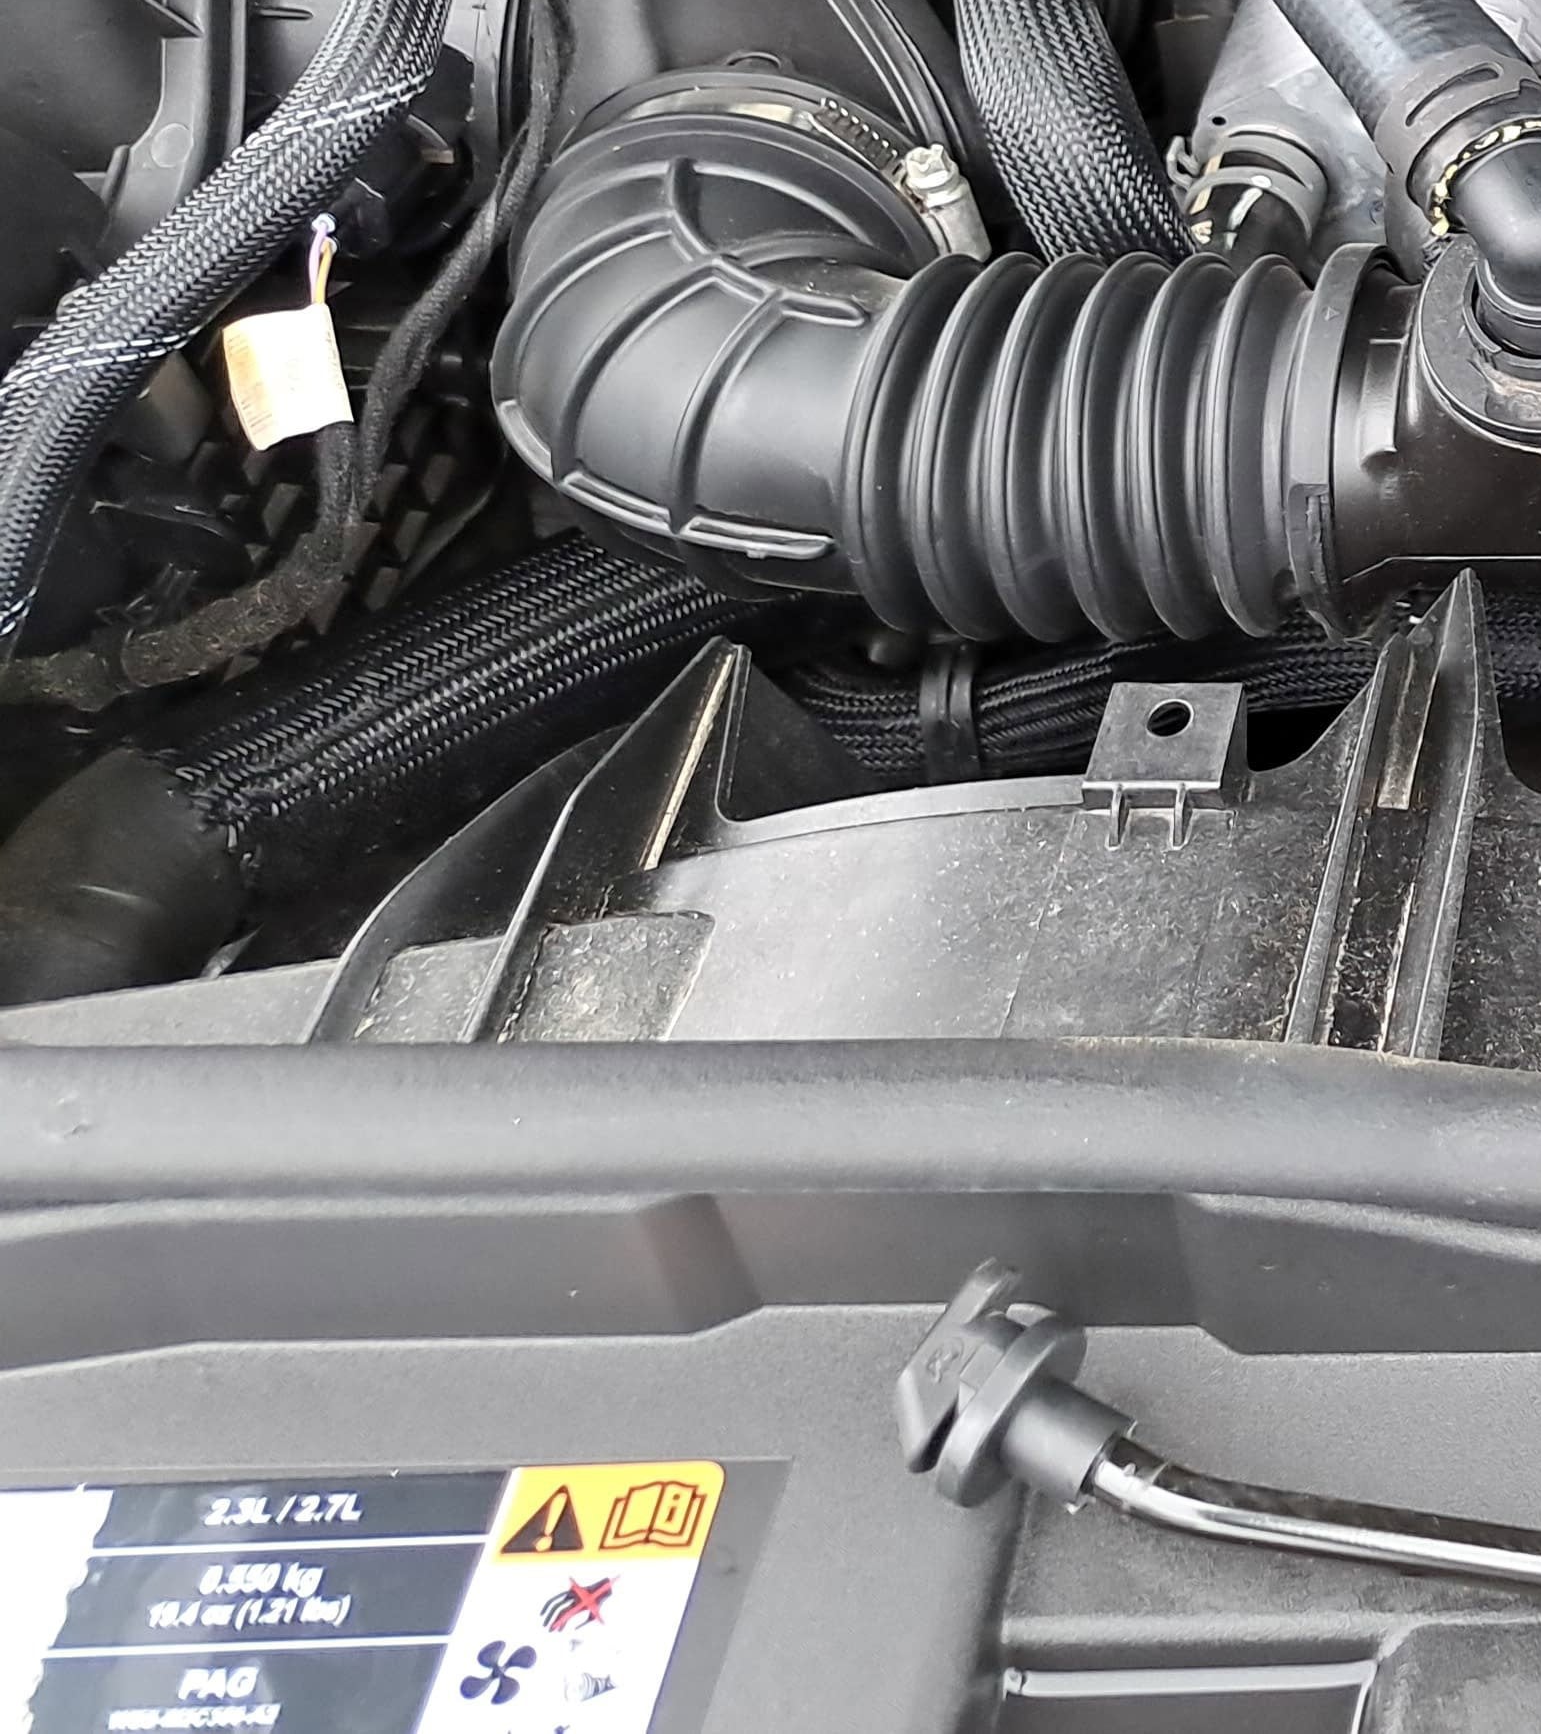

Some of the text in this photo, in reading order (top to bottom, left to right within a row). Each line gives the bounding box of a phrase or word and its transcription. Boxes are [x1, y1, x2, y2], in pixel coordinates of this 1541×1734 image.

[204, 1497, 273, 1526] 2.3L
[294, 1493, 364, 1523] 2.7L
[282, 1562, 325, 1598] kg
[177, 1667, 260, 1701] PAG
